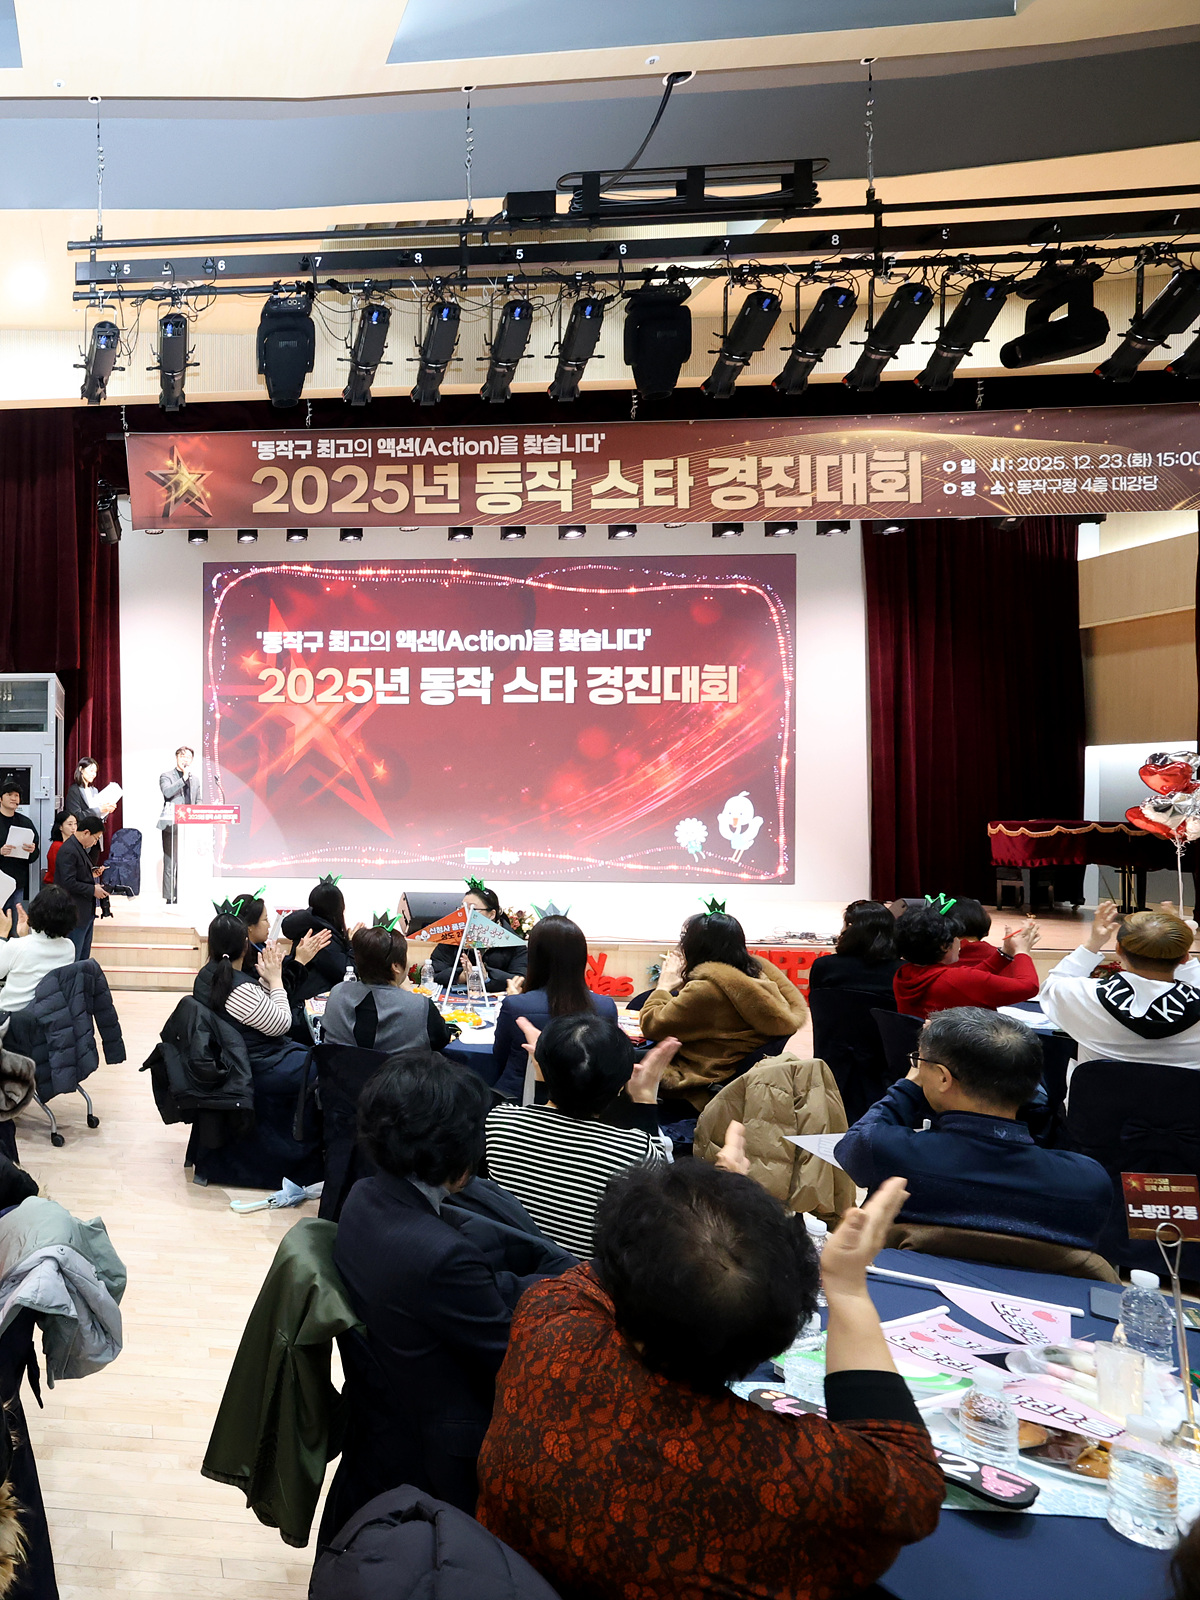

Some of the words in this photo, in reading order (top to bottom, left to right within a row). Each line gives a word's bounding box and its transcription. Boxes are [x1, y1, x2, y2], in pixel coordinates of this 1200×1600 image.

[831, 234, 840, 245] 8
[516, 249, 524, 259] 5
[619, 244, 627, 255] 6
[123, 264, 131, 275] 5
[218, 260, 226, 271] 6
[315, 257, 322, 267] 7
[316, 438, 372, 459] 최고의
[377, 435, 518, 458] 액션(Action)을
[1017, 456, 1069, 471] 2025.
[1072, 455, 1095, 470] 12.
[251, 462, 460, 515] 2025년
[475, 460, 577, 515] 동작
[590, 457, 695, 510] 스타
[707, 450, 923, 511] 경진대회
[1017, 477, 1077, 495] 동작구청
[1081, 476, 1108, 493] 4층
[1112, 475, 1159, 491] 대강당
[328, 630, 391, 653] 최고의
[395, 629, 554, 653] 액션(Action)을
[257, 666, 410, 705] 2025년
[419, 666, 494, 706] 동작
[503, 666, 578, 704] 스타
[586, 664, 738, 706] 경진대회
[1128, 1203, 1171, 1219] 노량진
[1171, 1205, 1199, 1220] 2동
